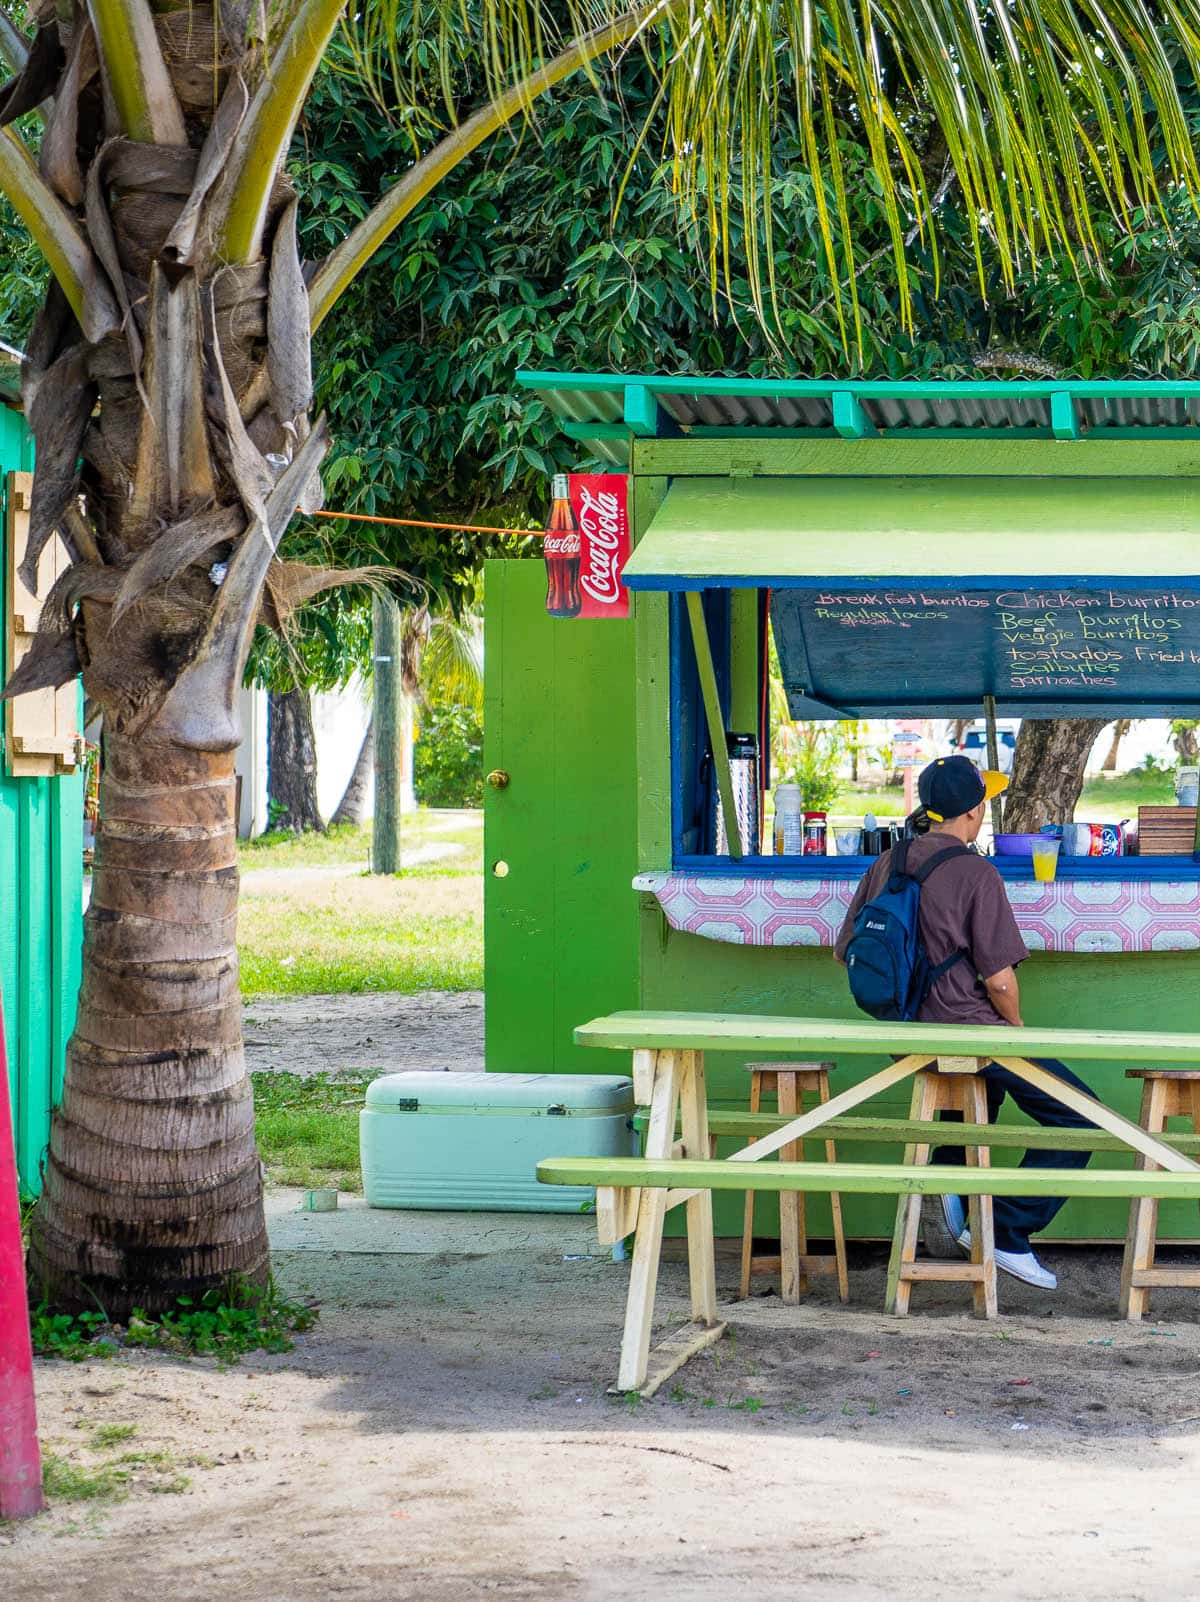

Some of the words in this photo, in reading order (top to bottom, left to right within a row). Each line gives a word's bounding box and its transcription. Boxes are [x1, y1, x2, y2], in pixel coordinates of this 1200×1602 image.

[580, 485, 619, 604] Coca-Cola
[884, 593, 917, 606] fast
[920, 592, 991, 607] burritos
[996, 592, 1100, 609] Chicken
[814, 606, 889, 620] Regular
[891, 606, 949, 620] tacos
[992, 611, 1058, 630] Beef
[1078, 610, 1183, 630] burritos
[1084, 626, 1170, 643] burritos
[1135, 647, 1185, 662] Fried
[1010, 659, 1120, 675] Salbutes
[1010, 673, 1118, 688] garnaches
